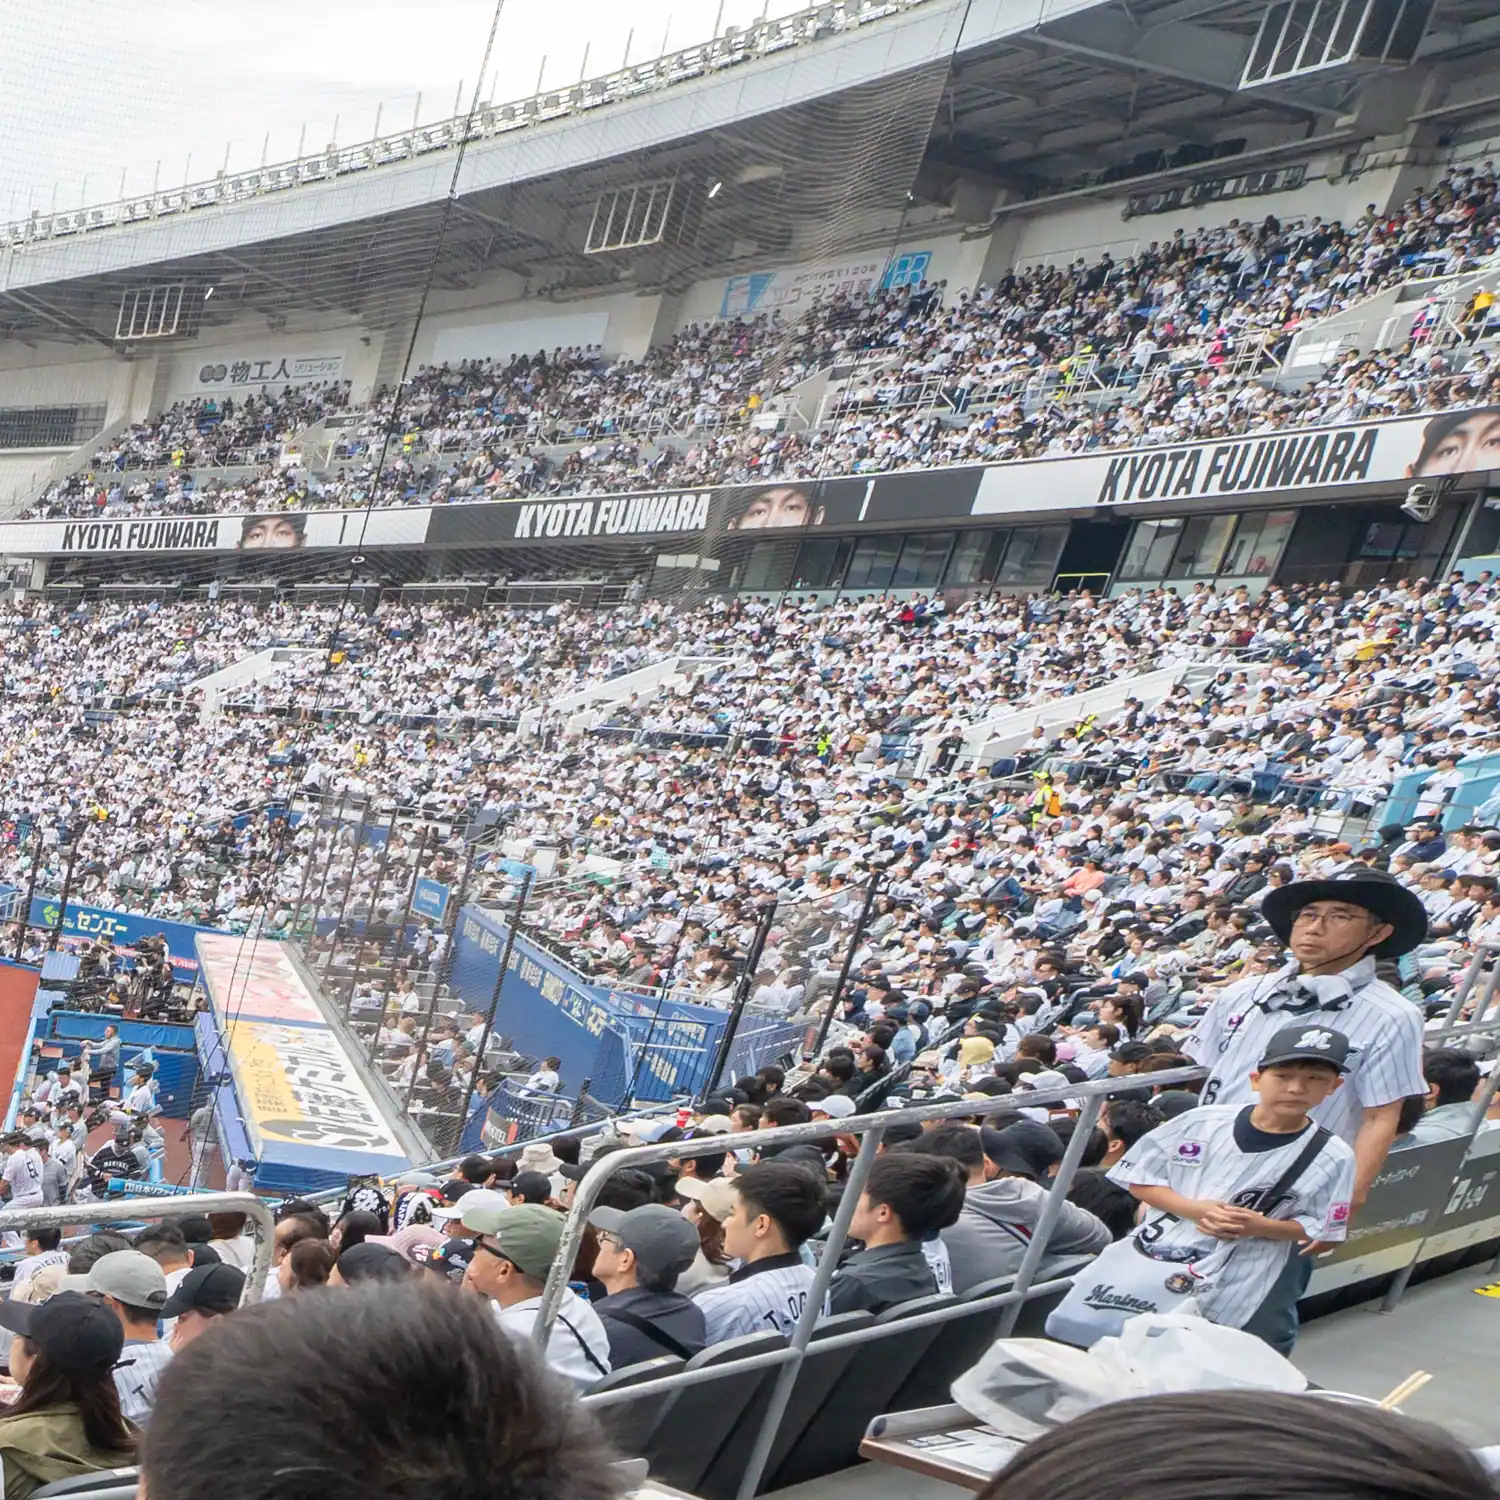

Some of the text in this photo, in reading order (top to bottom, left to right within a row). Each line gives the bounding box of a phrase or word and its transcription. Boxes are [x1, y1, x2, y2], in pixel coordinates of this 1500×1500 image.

[1098, 429, 1379, 503] KYOTA FUJIWARA
[62, 520, 219, 550] KYOTA FUJIWARA
[515, 493, 711, 538] KYOTA FUJIWARA
